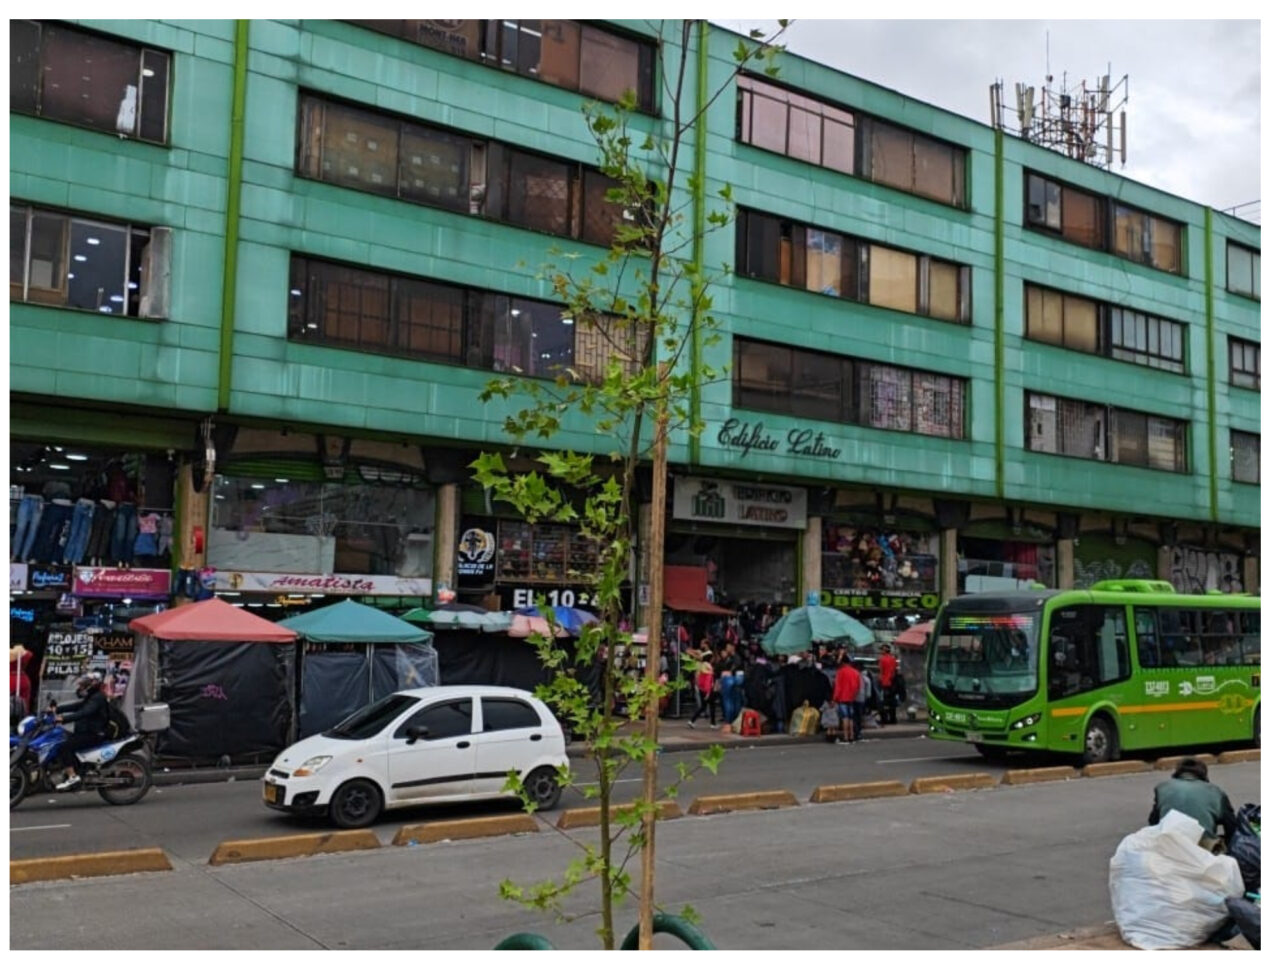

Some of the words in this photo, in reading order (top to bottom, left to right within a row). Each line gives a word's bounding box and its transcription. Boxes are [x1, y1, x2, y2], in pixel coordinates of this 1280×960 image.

[717, 418, 779, 459] Edificio
[786, 428, 843, 460] Latino
[270, 574, 376, 591] Amatista
[549, 589, 575, 609] 10
